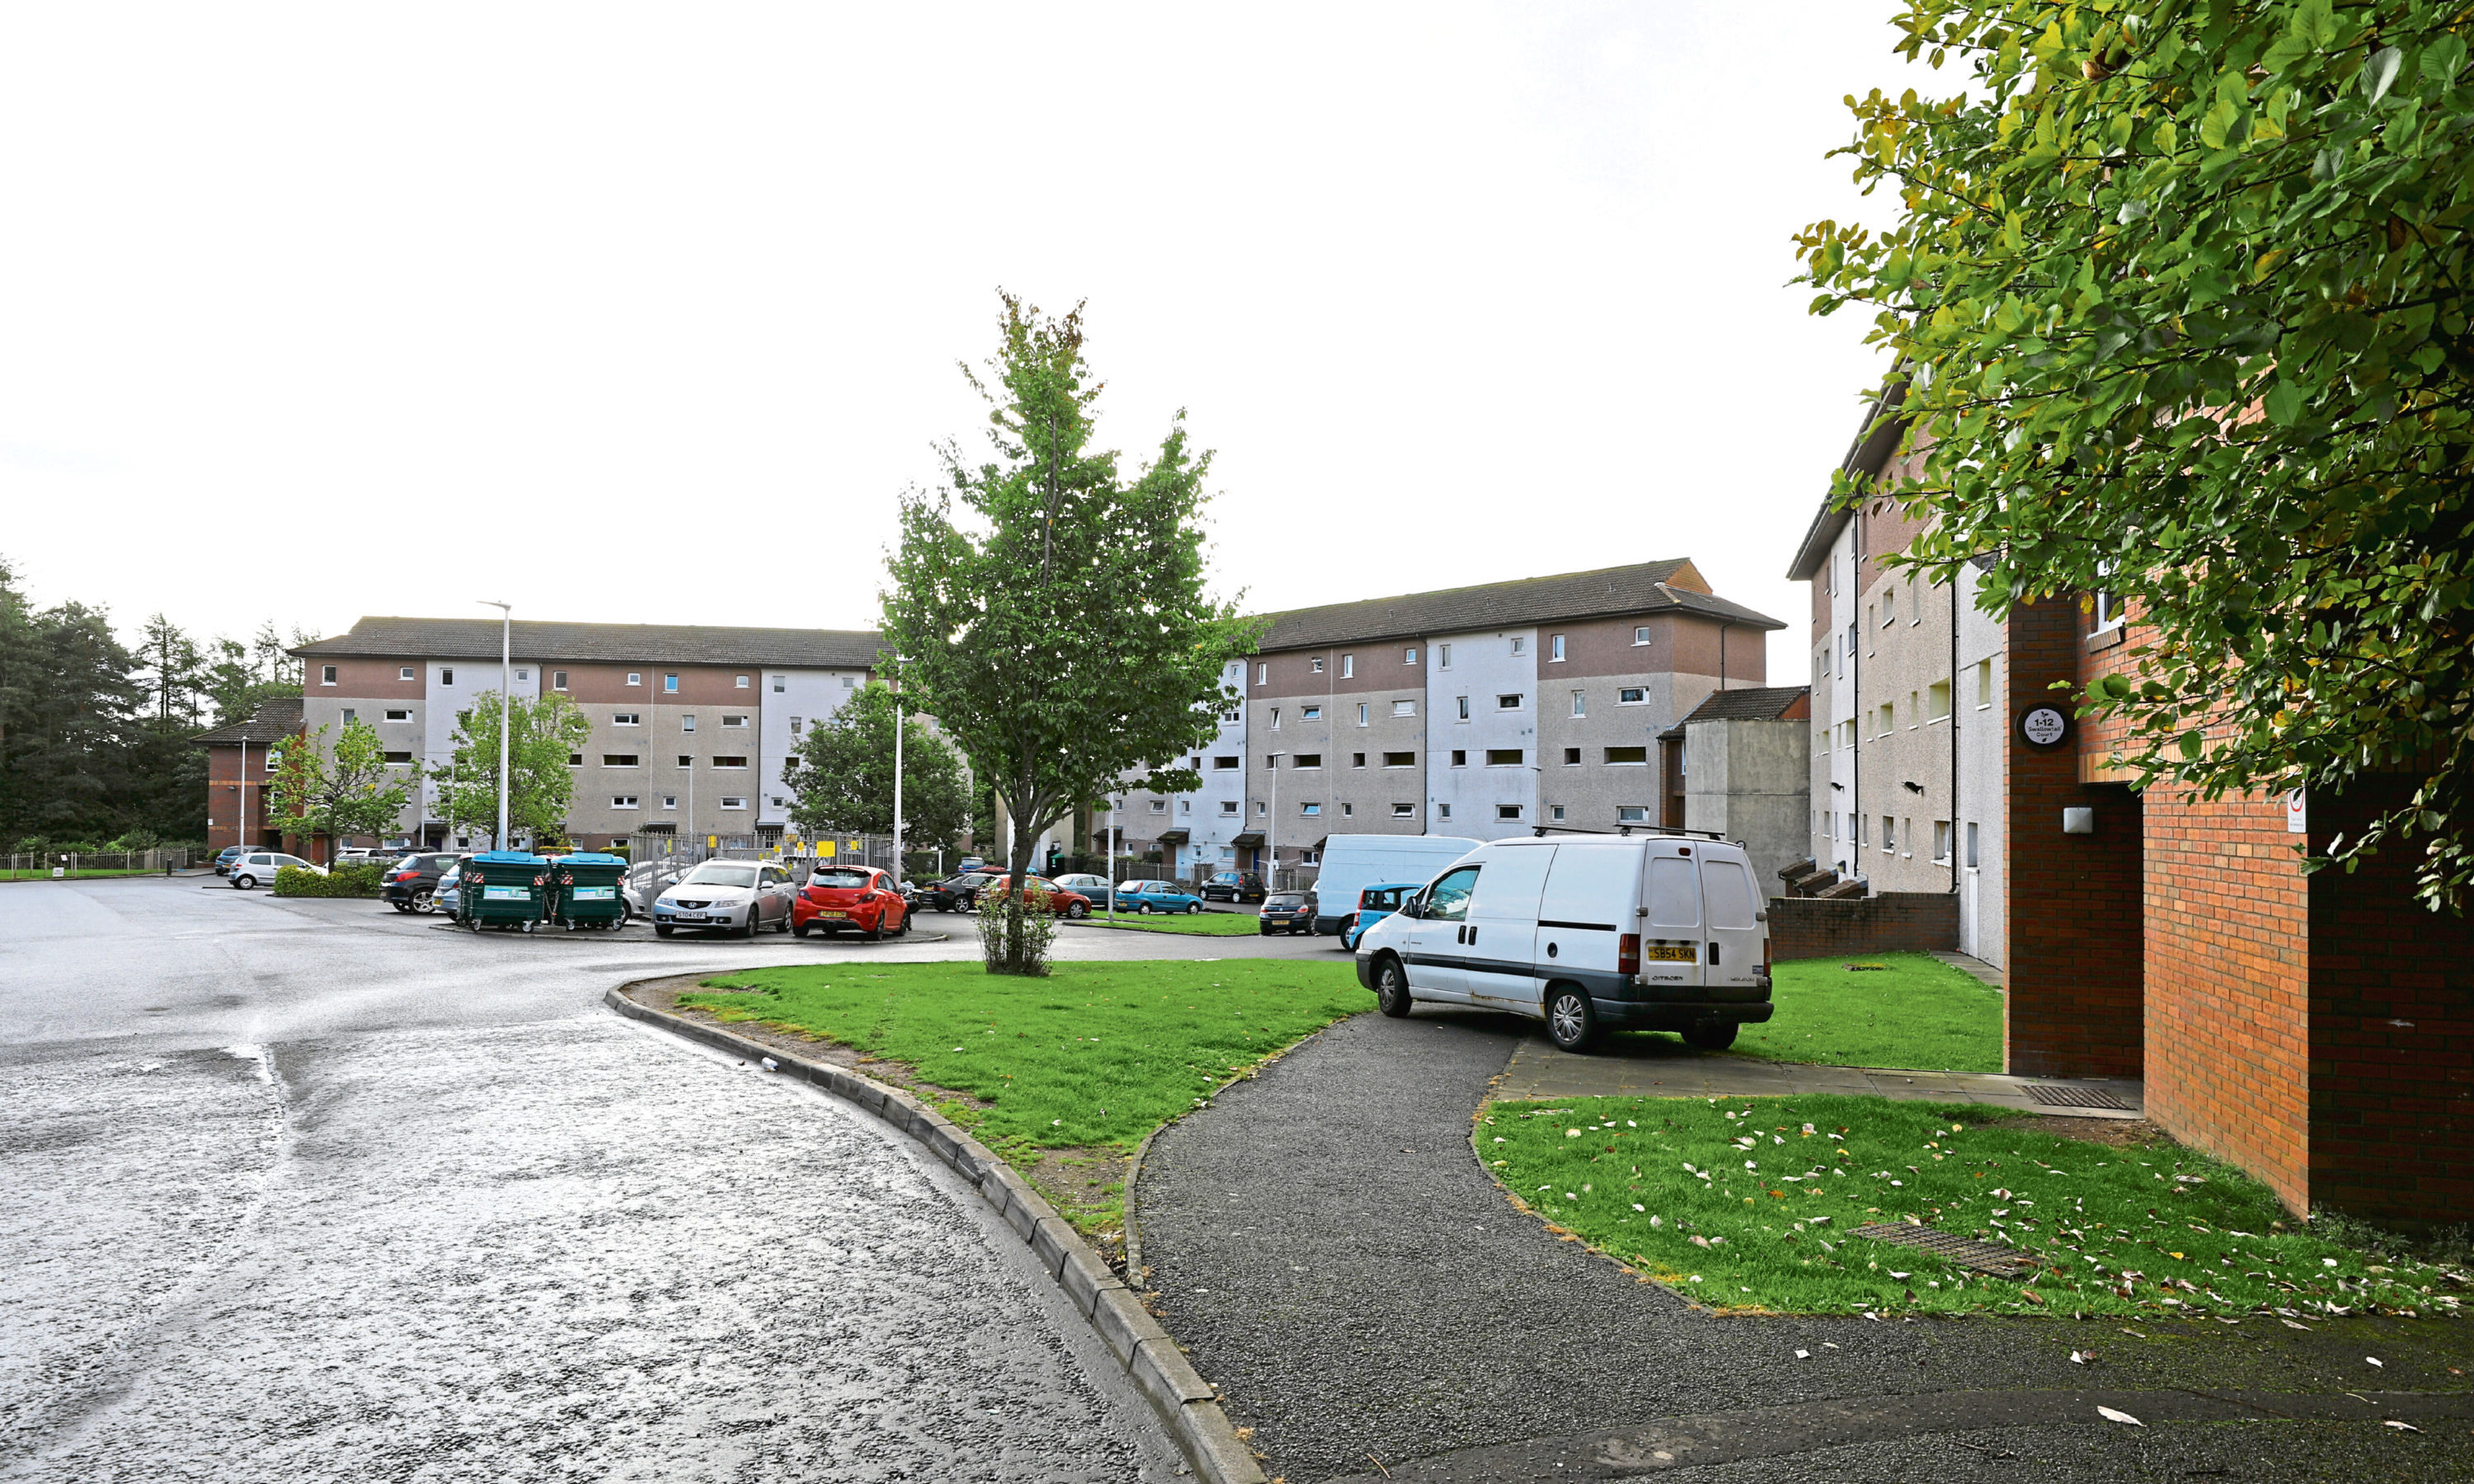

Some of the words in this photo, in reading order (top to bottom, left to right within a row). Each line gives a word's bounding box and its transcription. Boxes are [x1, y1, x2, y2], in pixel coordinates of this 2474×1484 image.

[2034, 718, 2054, 726] 1-12
[1654, 948, 1677, 959] SB54
[1678, 949, 1696, 960] SKN
